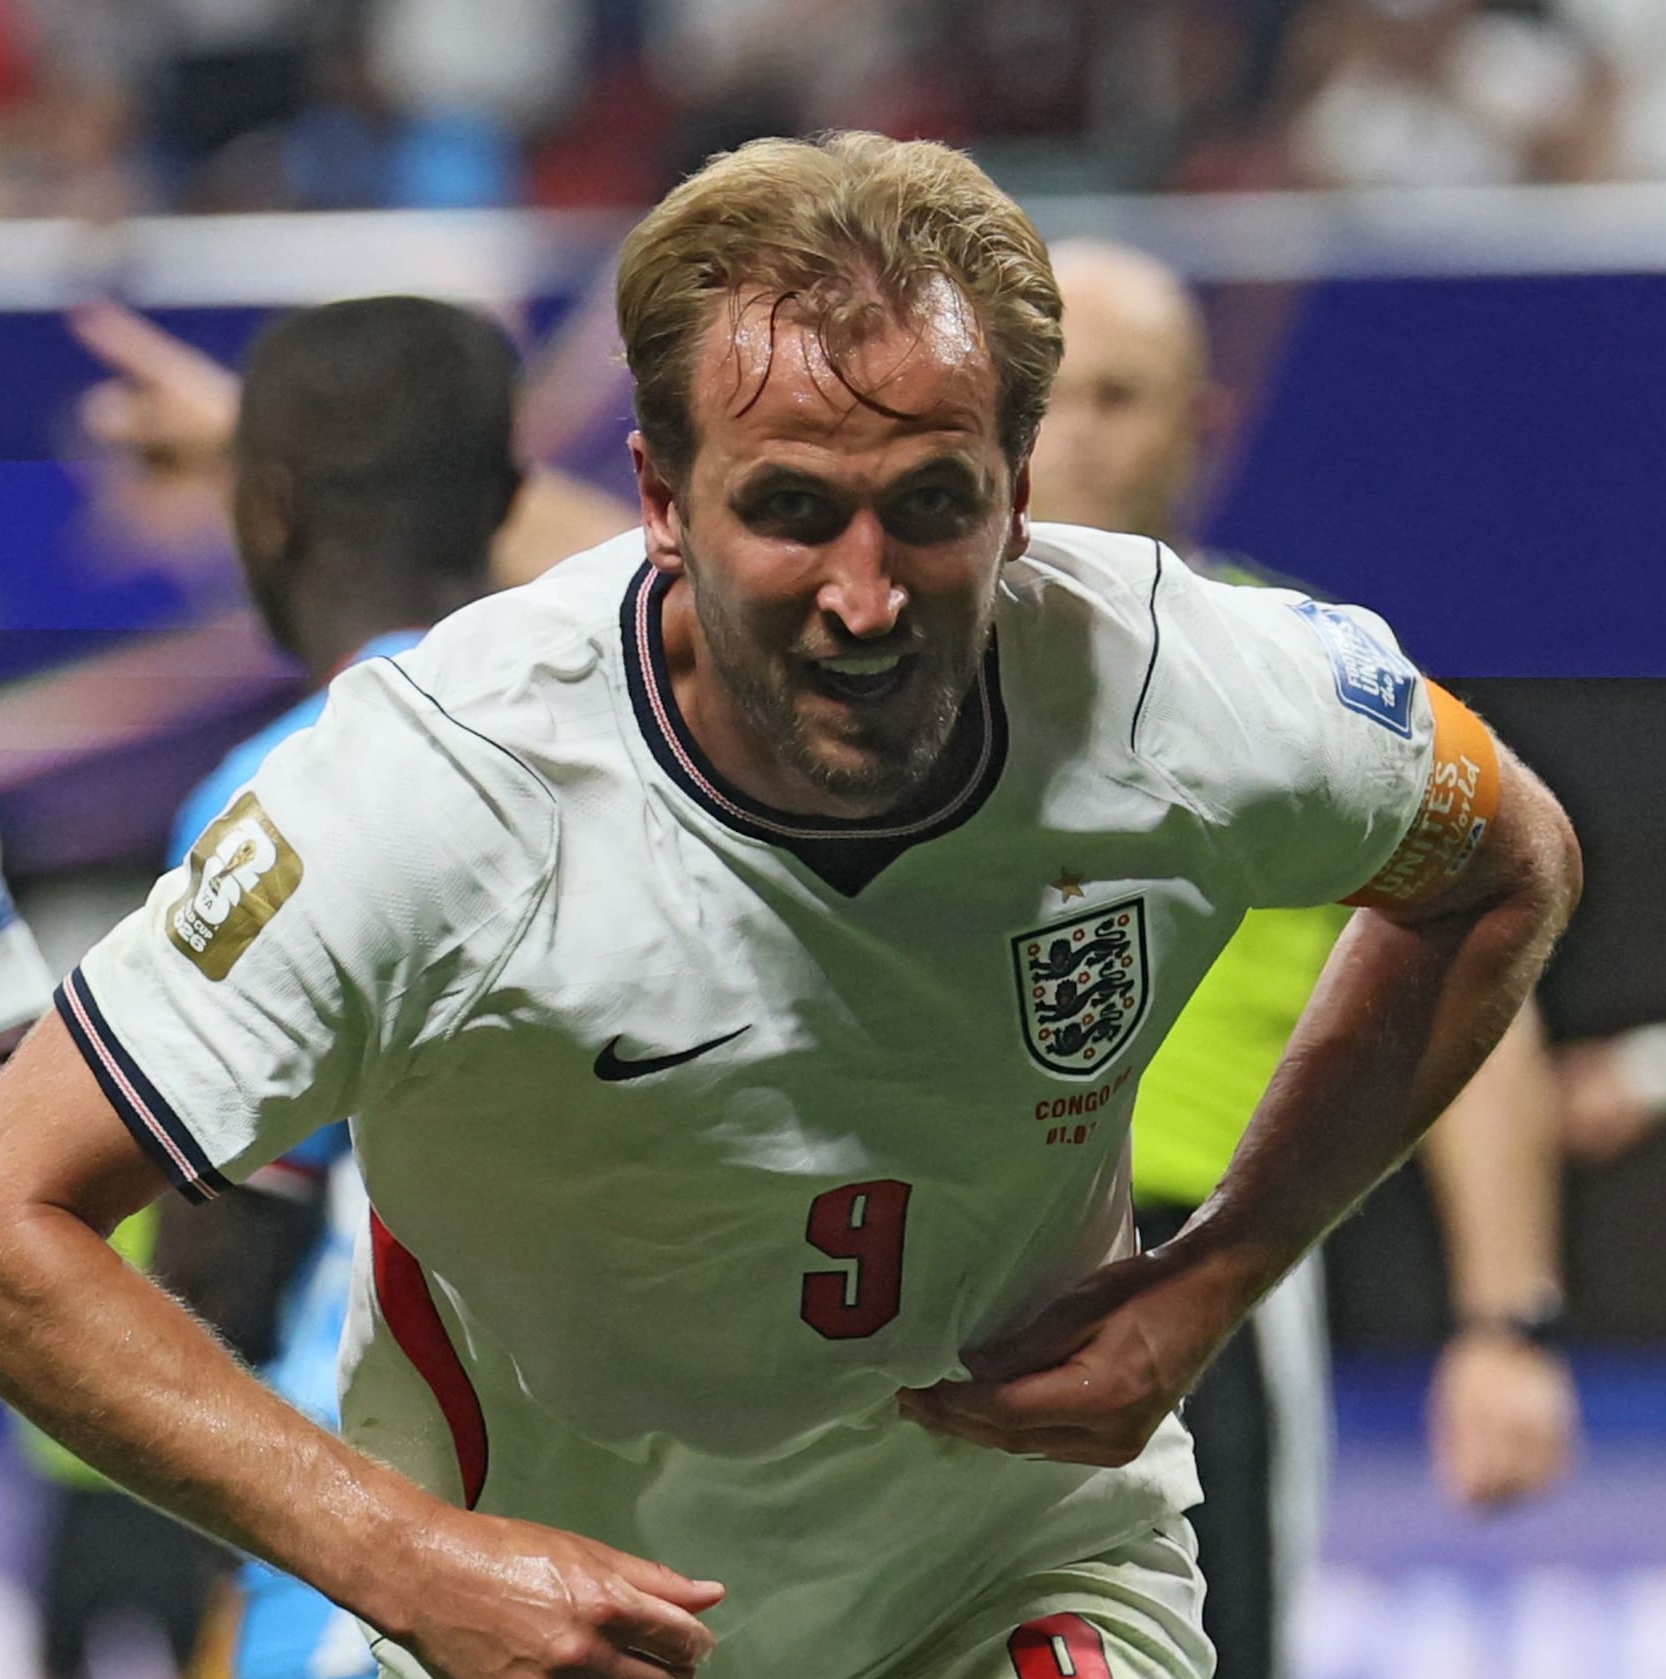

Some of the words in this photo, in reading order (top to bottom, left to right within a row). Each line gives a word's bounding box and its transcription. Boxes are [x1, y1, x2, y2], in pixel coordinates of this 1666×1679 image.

[194, 919, 213, 940] CUP
[1035, 1085, 1110, 1121] CONGO
[800, 1179, 913, 1341] 9
